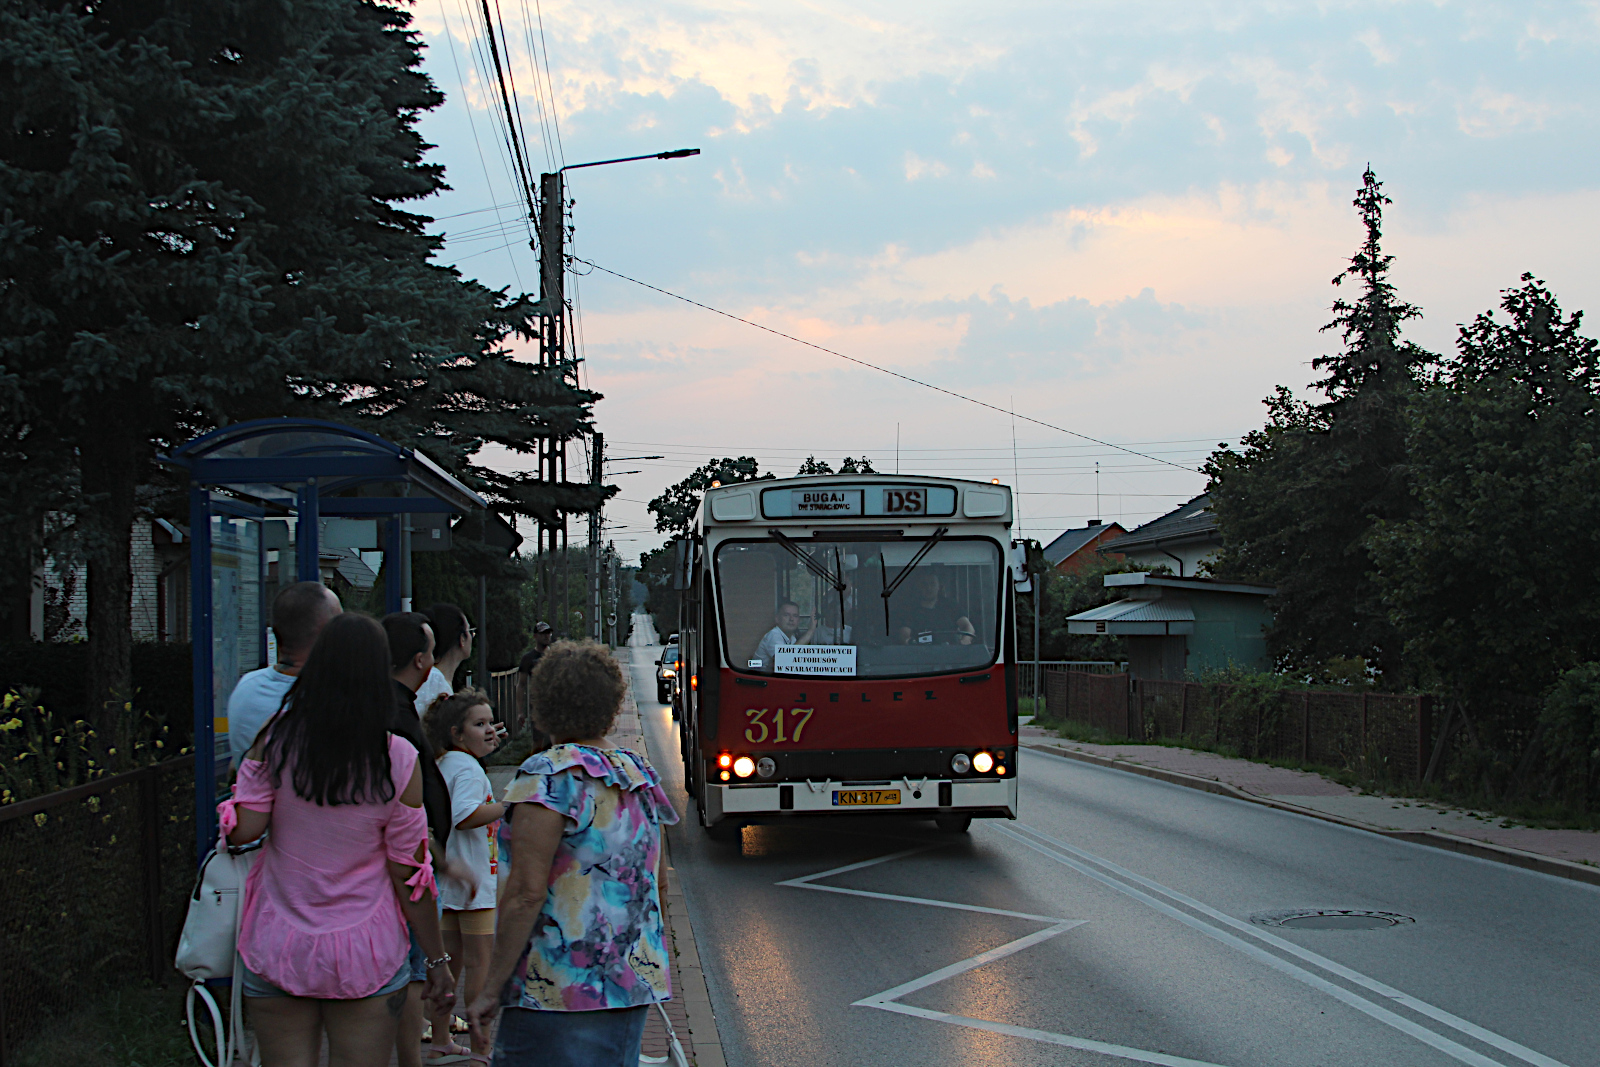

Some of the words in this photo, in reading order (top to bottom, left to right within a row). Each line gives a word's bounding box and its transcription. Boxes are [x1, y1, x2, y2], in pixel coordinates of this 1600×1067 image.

[803, 493, 845, 502] BUGAJ
[887, 491, 922, 512] DS
[797, 647, 852, 655] ZABYTKOWYCH
[792, 656, 838, 664] AUTOBUSÓW
[744, 707, 814, 743] 317
[840, 792, 857, 804] KN
[861, 791, 882, 804] 317
